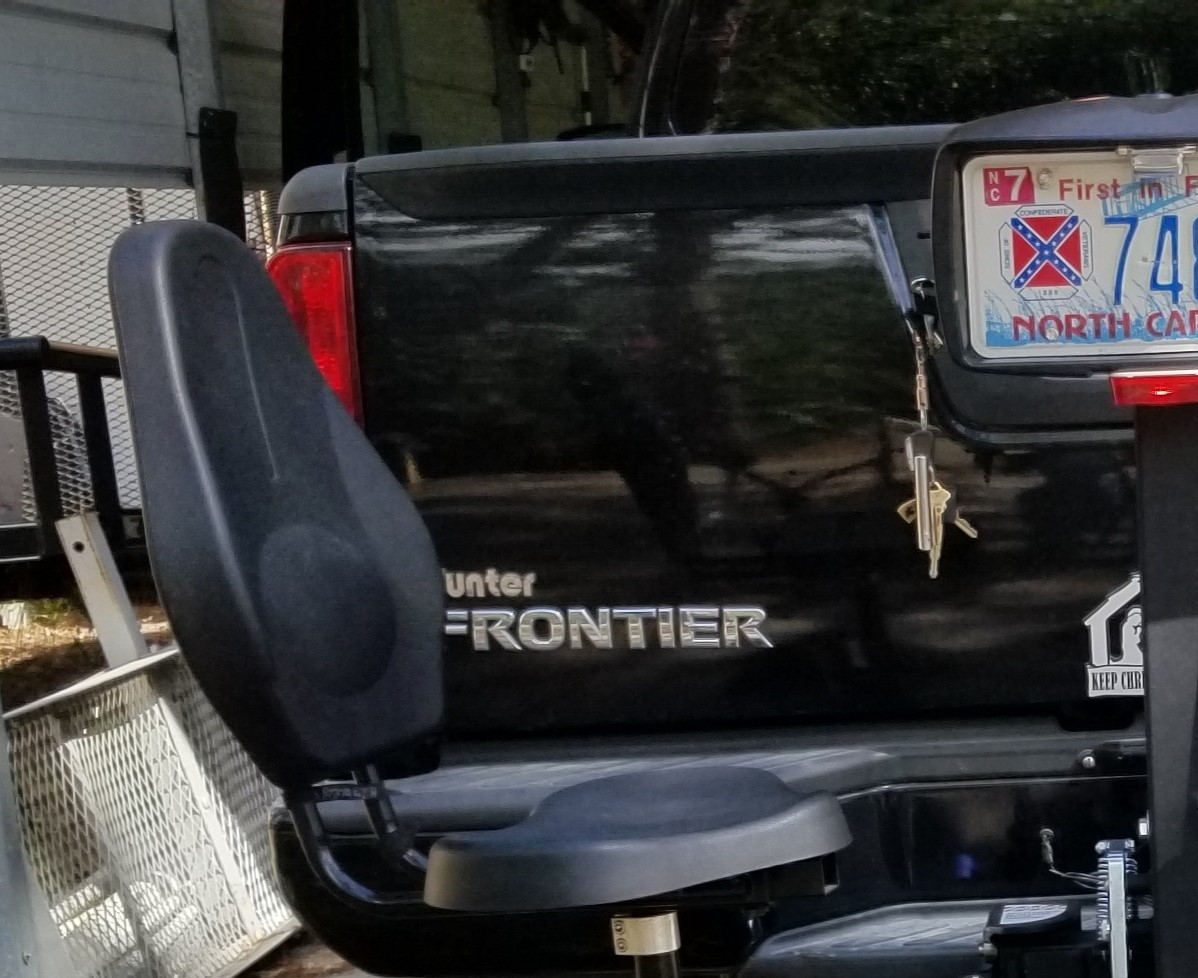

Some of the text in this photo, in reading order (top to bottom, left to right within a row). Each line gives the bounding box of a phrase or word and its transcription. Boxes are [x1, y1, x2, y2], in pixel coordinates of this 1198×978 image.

[1004, 169, 1029, 202] 7
[1058, 178, 1120, 201] First
[1012, 312, 1131, 342] NORTH
[441, 568, 536, 598] unter
[1091, 671, 1118, 691] KEEP
